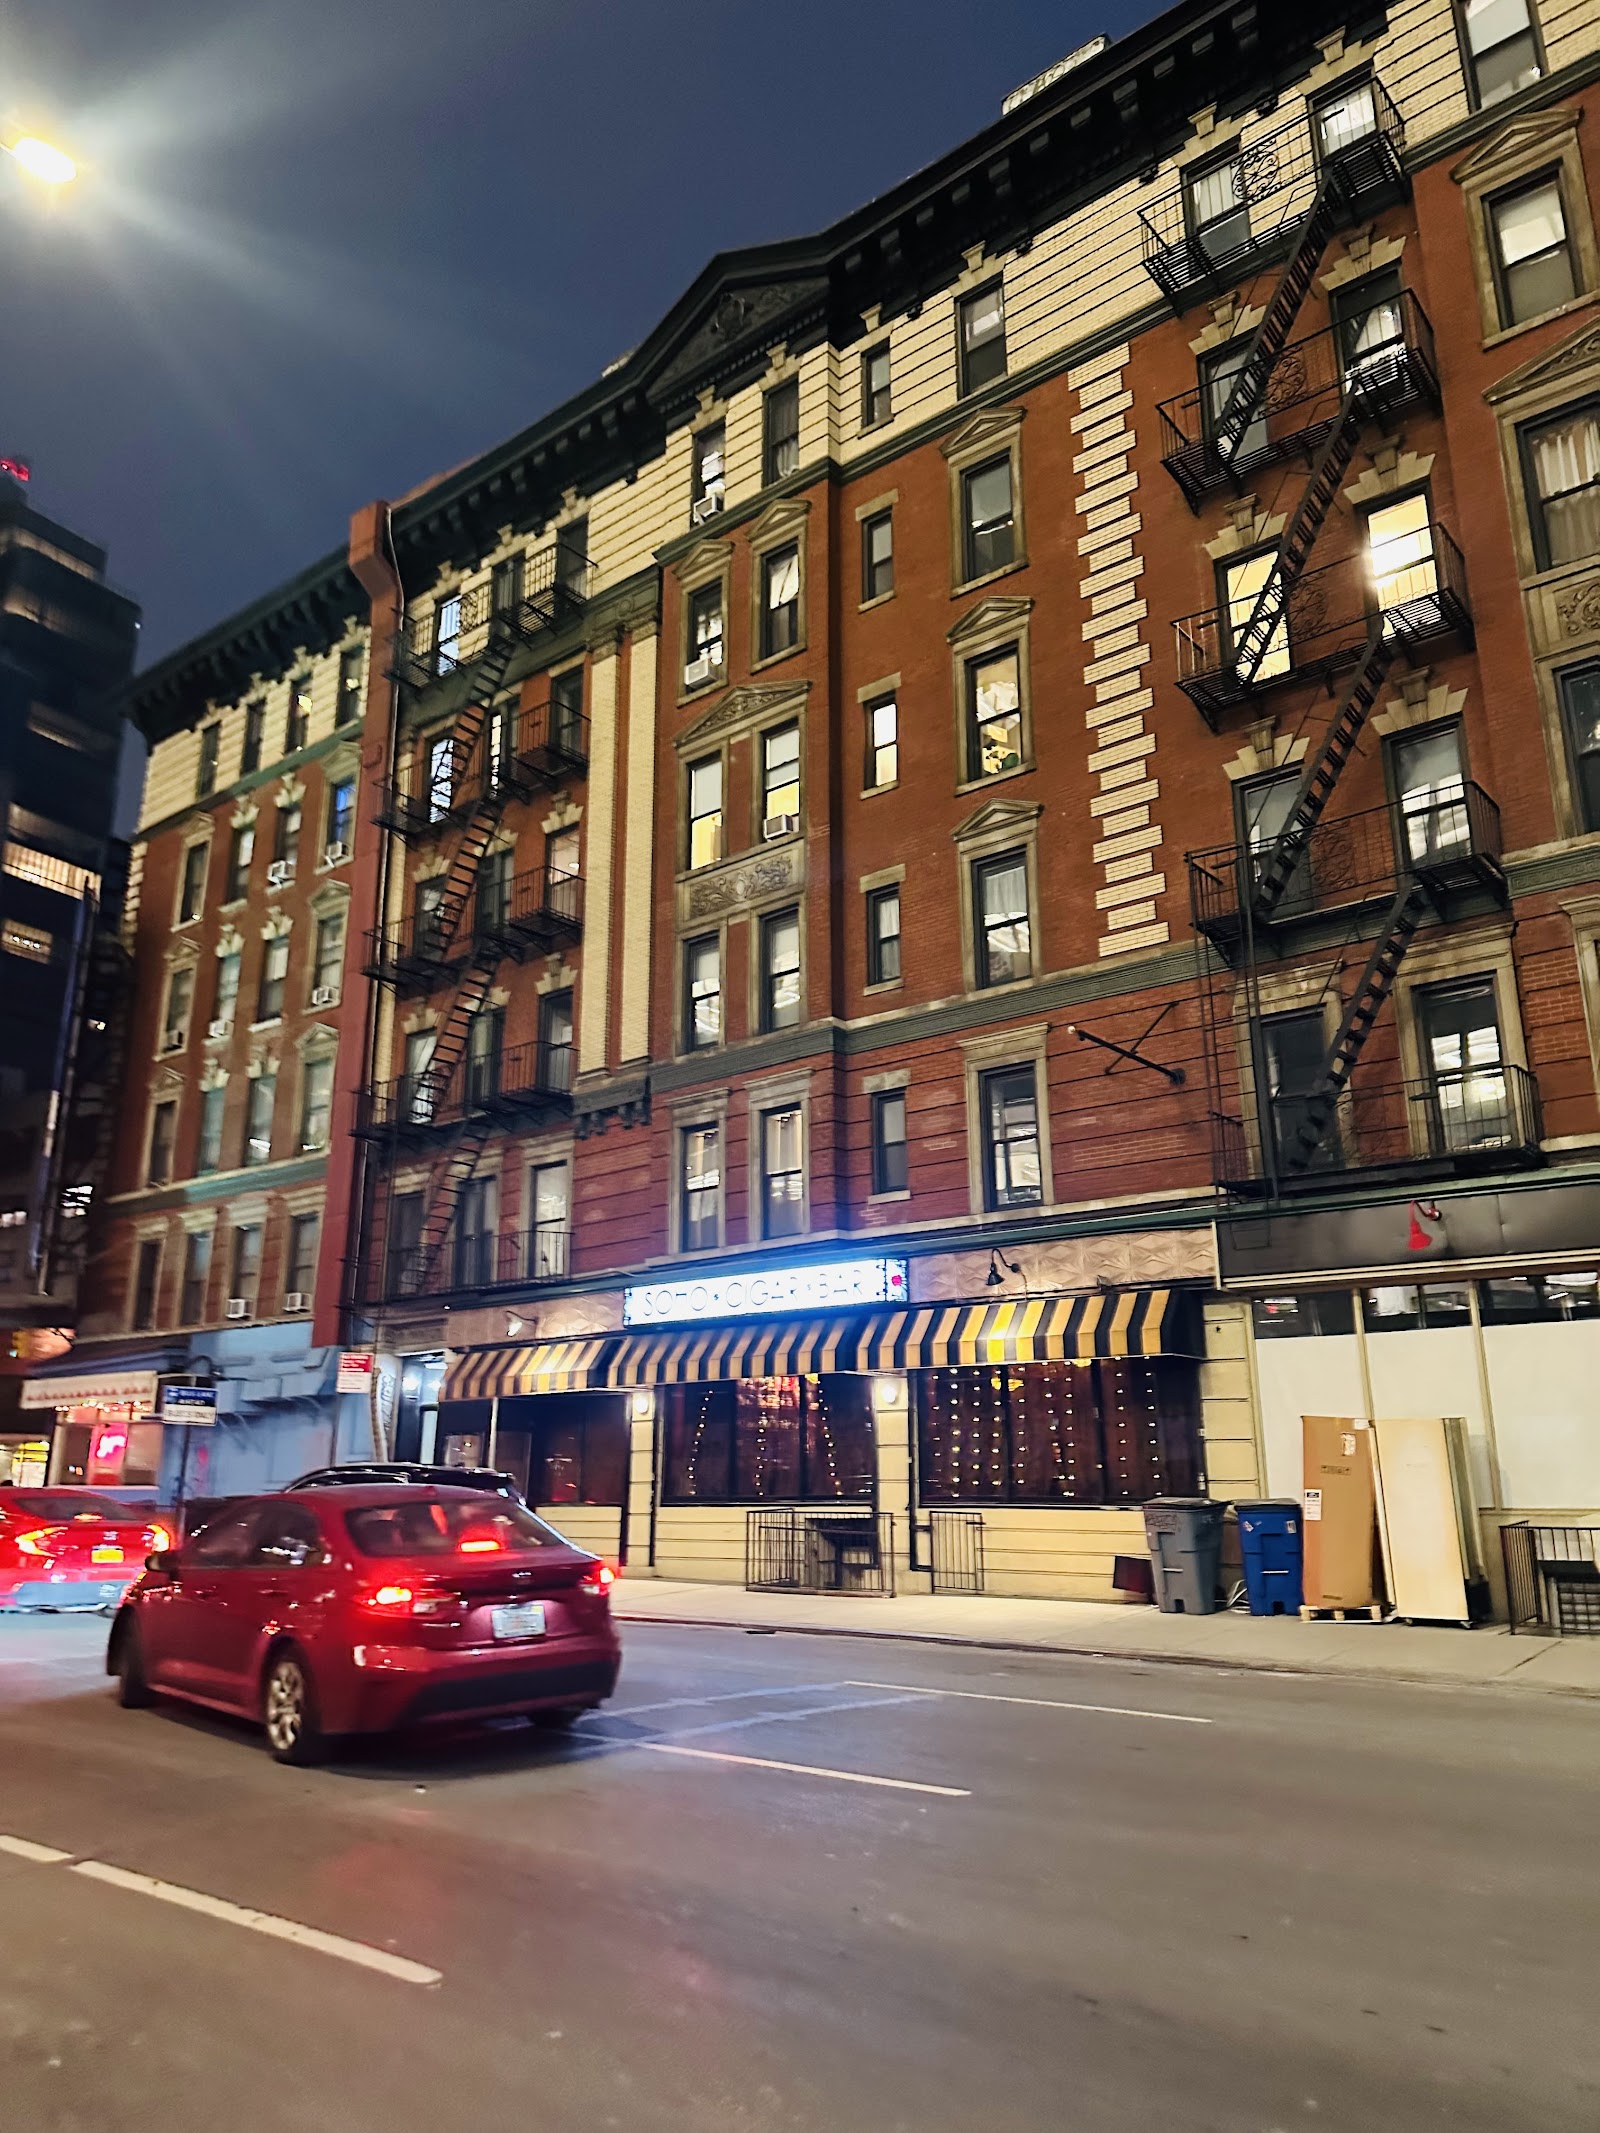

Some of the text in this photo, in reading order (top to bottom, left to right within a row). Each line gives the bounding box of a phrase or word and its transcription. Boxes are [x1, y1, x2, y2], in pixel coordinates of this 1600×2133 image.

[643, 1269, 864, 1317] SOHO CIGAR BAR
